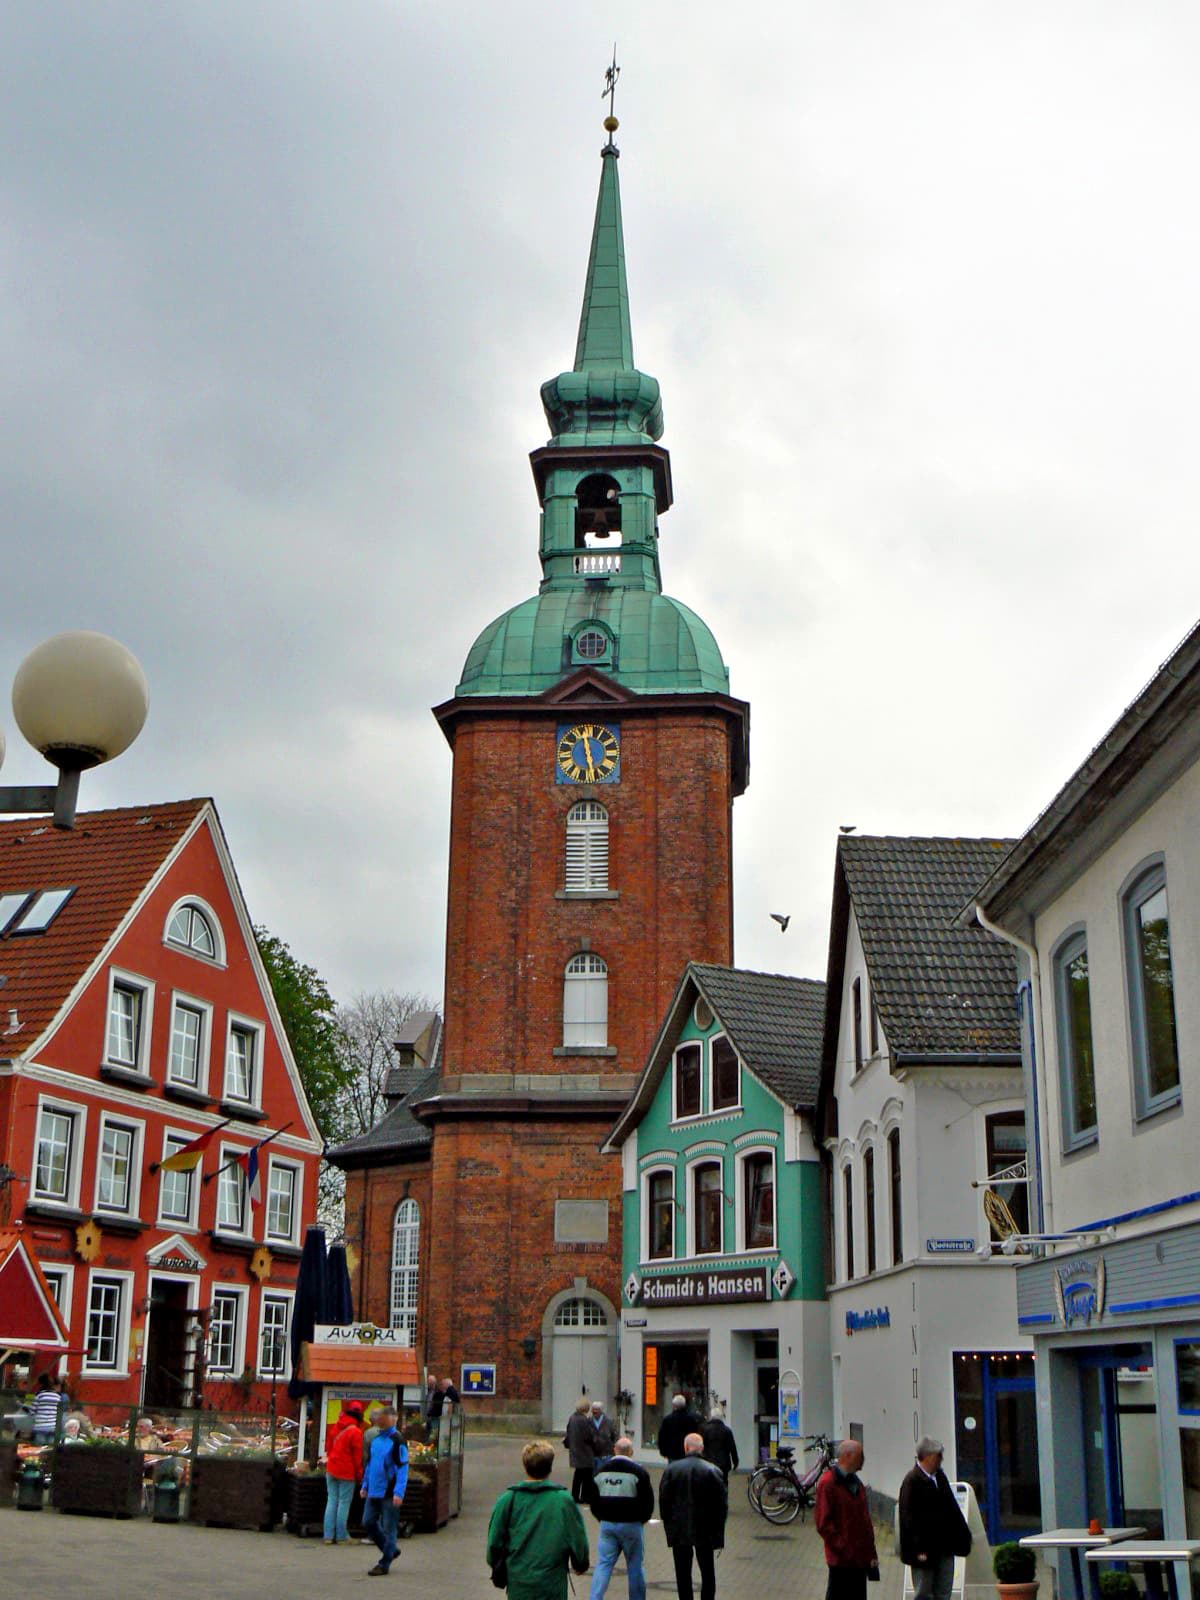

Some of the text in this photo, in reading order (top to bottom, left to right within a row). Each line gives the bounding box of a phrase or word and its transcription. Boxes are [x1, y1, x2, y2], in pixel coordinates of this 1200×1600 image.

[643, 1275, 763, 1299] Schmidt & Hansen
[327, 1327, 397, 1341] AURORA
